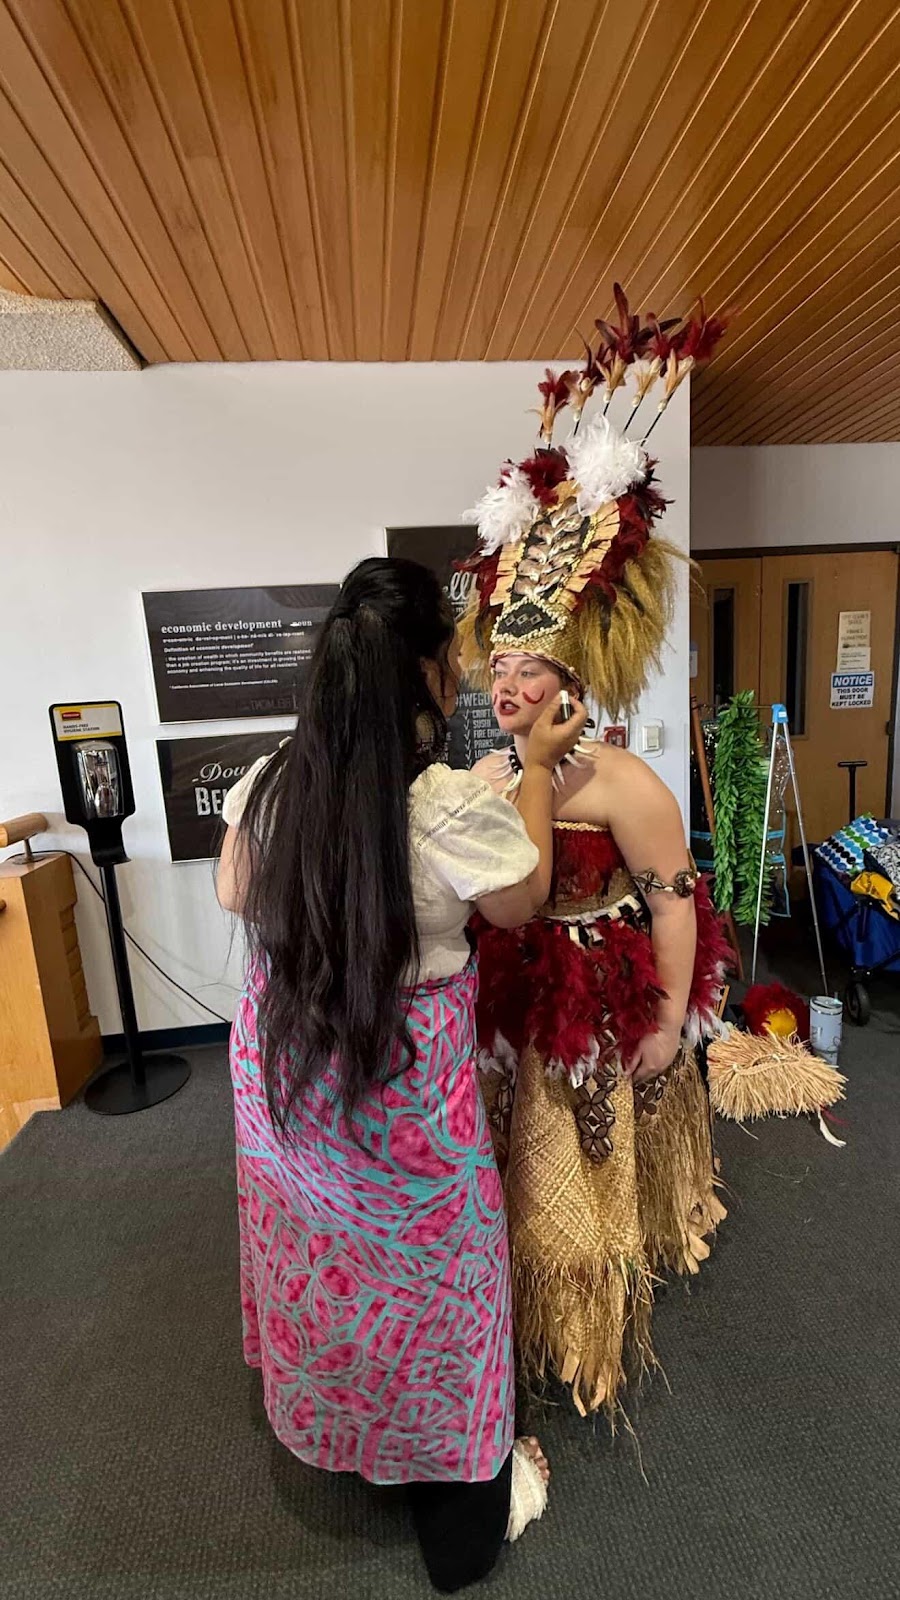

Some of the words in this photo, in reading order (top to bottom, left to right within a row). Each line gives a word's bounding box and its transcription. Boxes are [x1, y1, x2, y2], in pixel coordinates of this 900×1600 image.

[161, 622, 212, 634] economic
[214, 620, 282, 632] development
[239, 651, 264, 659] community
[834, 675, 872, 687] NOTICE
[472, 719, 491, 729] SUSHI
[473, 729, 487, 739] FIRE
[474, 739, 494, 749] PARKS
[194, 786, 227, 816] BE
